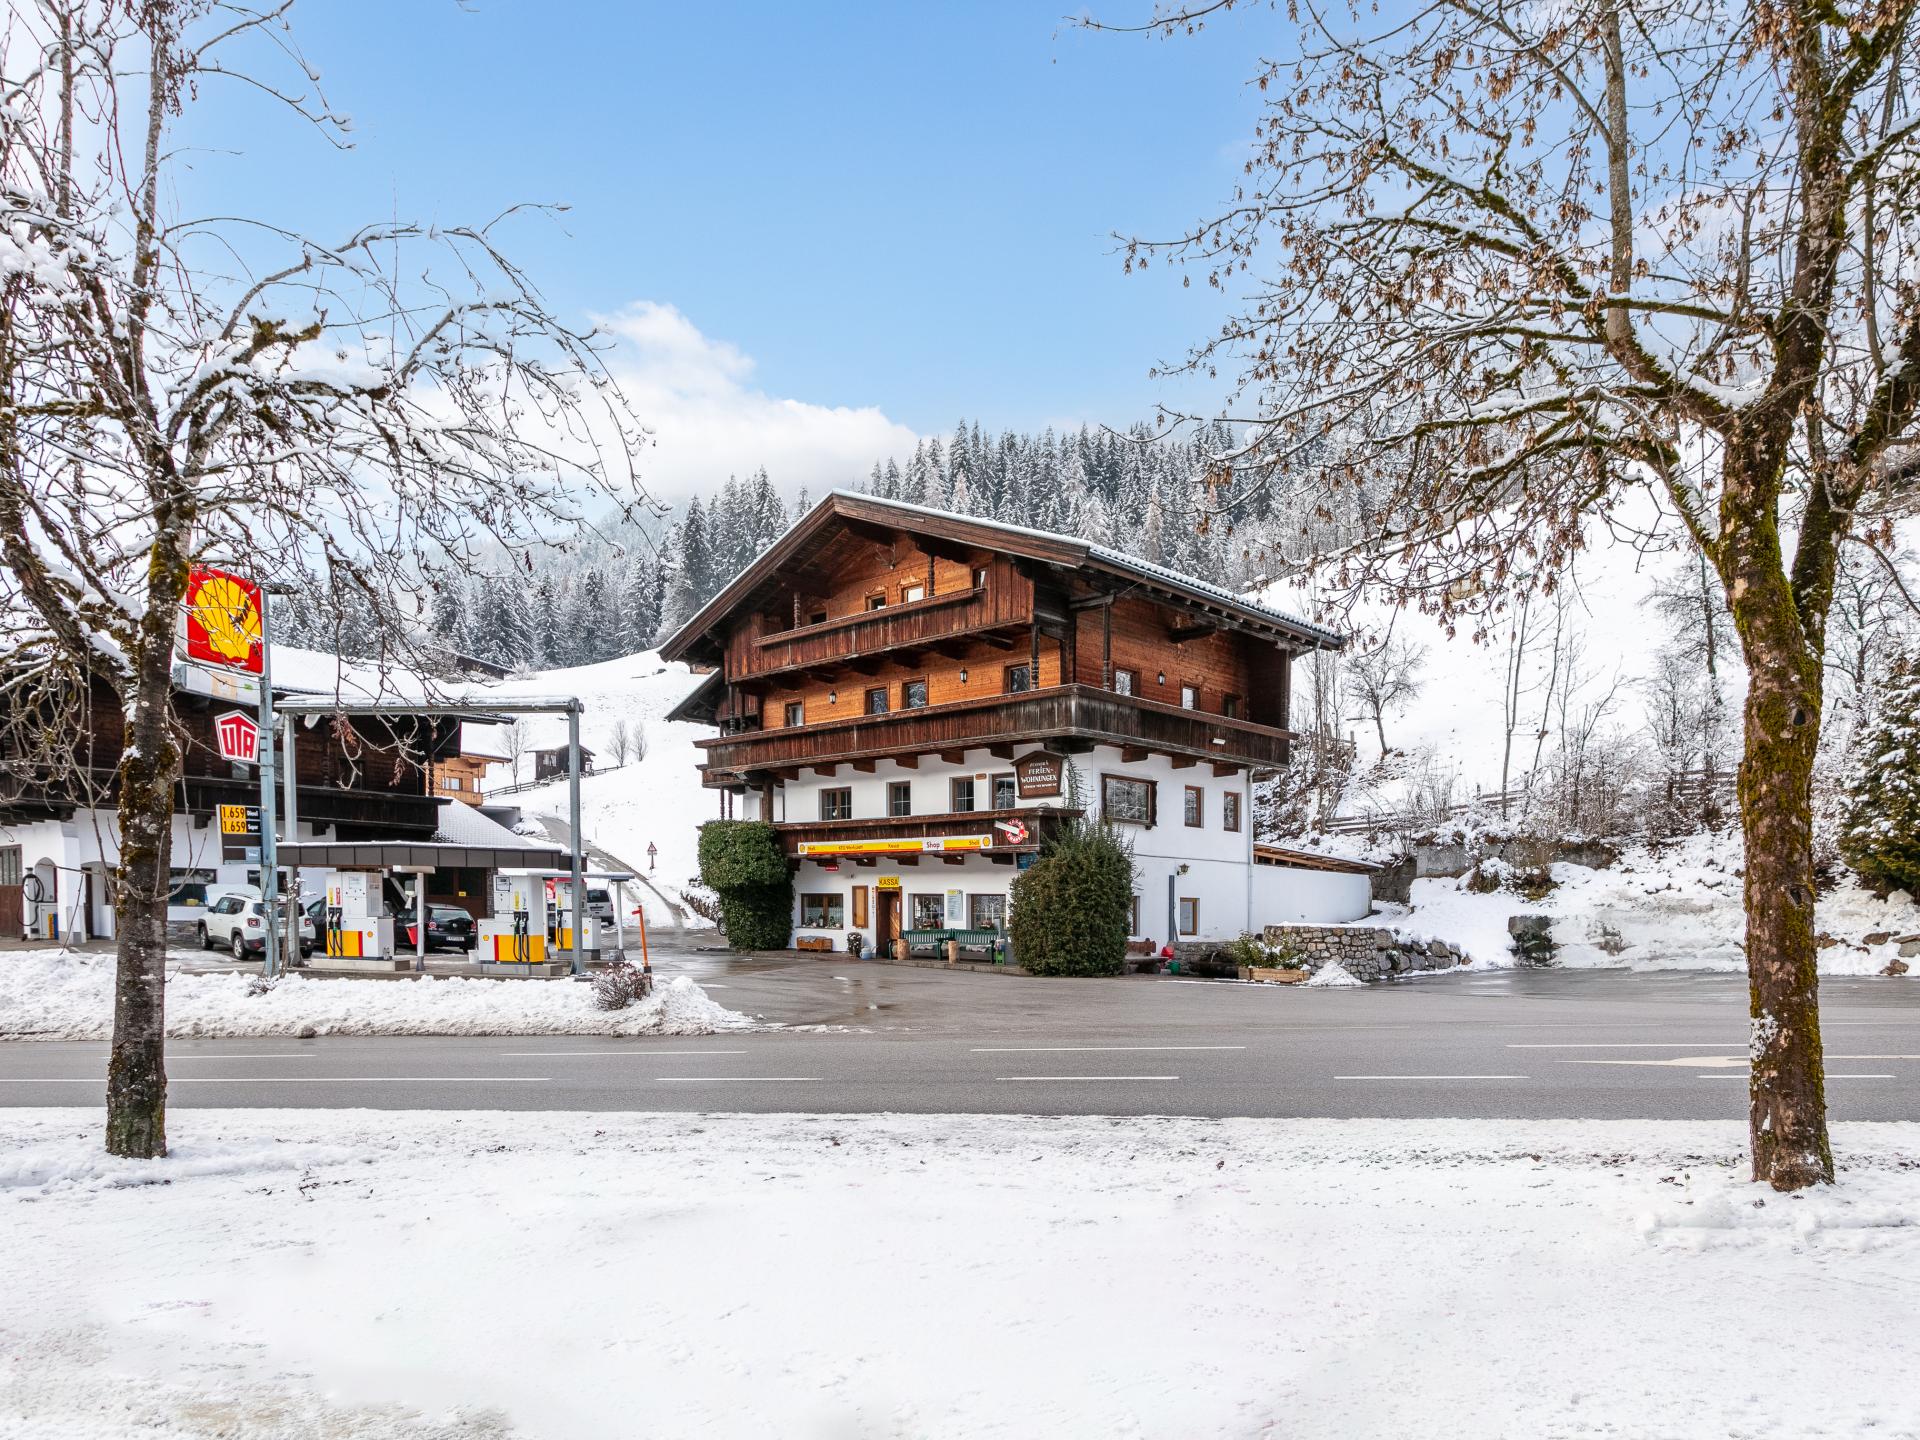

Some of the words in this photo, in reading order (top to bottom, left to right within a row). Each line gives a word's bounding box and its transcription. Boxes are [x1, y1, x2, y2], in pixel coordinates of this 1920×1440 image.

[219, 715, 257, 758] UTA
[222, 806, 245, 819] 1.659
[223, 820, 246, 832] 1.659
[926, 841, 940, 850] Shop
[879, 878, 899, 887] KASSA
